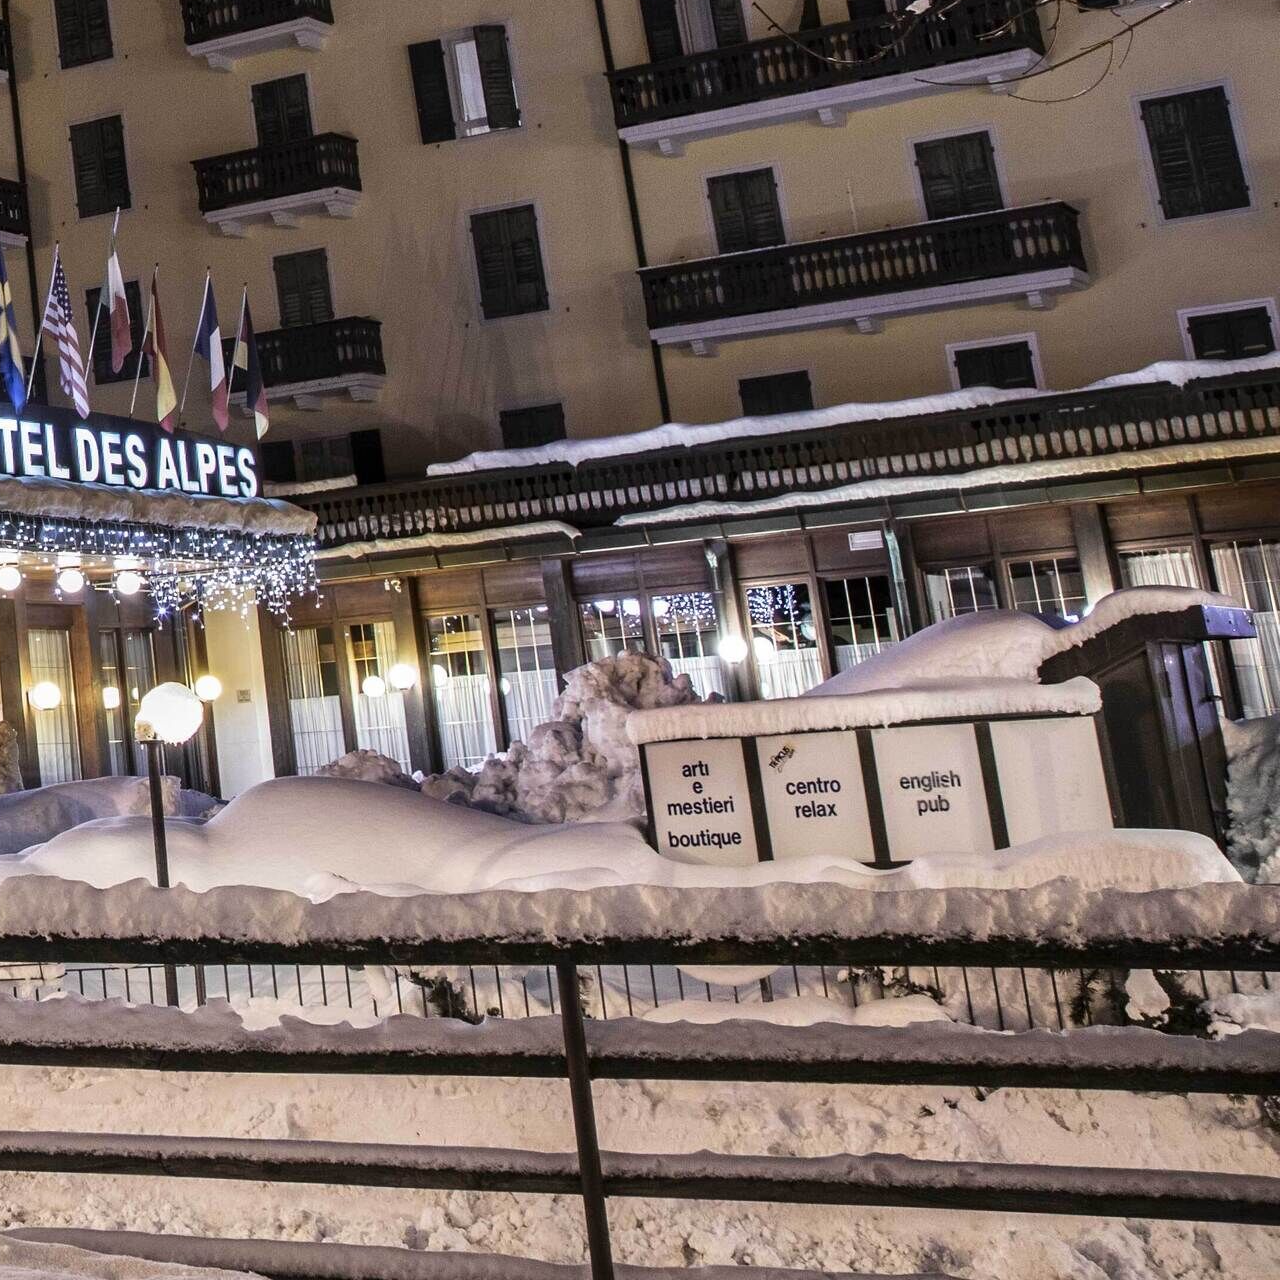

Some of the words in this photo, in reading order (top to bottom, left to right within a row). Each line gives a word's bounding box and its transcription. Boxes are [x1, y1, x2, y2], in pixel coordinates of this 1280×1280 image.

[75, 427, 147, 489] DES
[157, 438, 258, 498] ALPES
[682, 760, 709, 777] arti
[692, 781, 703, 794] e
[785, 776, 841, 795] centro
[899, 770, 961, 792] english
[667, 795, 735, 816] mestieri
[795, 800, 838, 819] relax
[917, 794, 950, 816] pub
[667, 828, 742, 849] boutique
